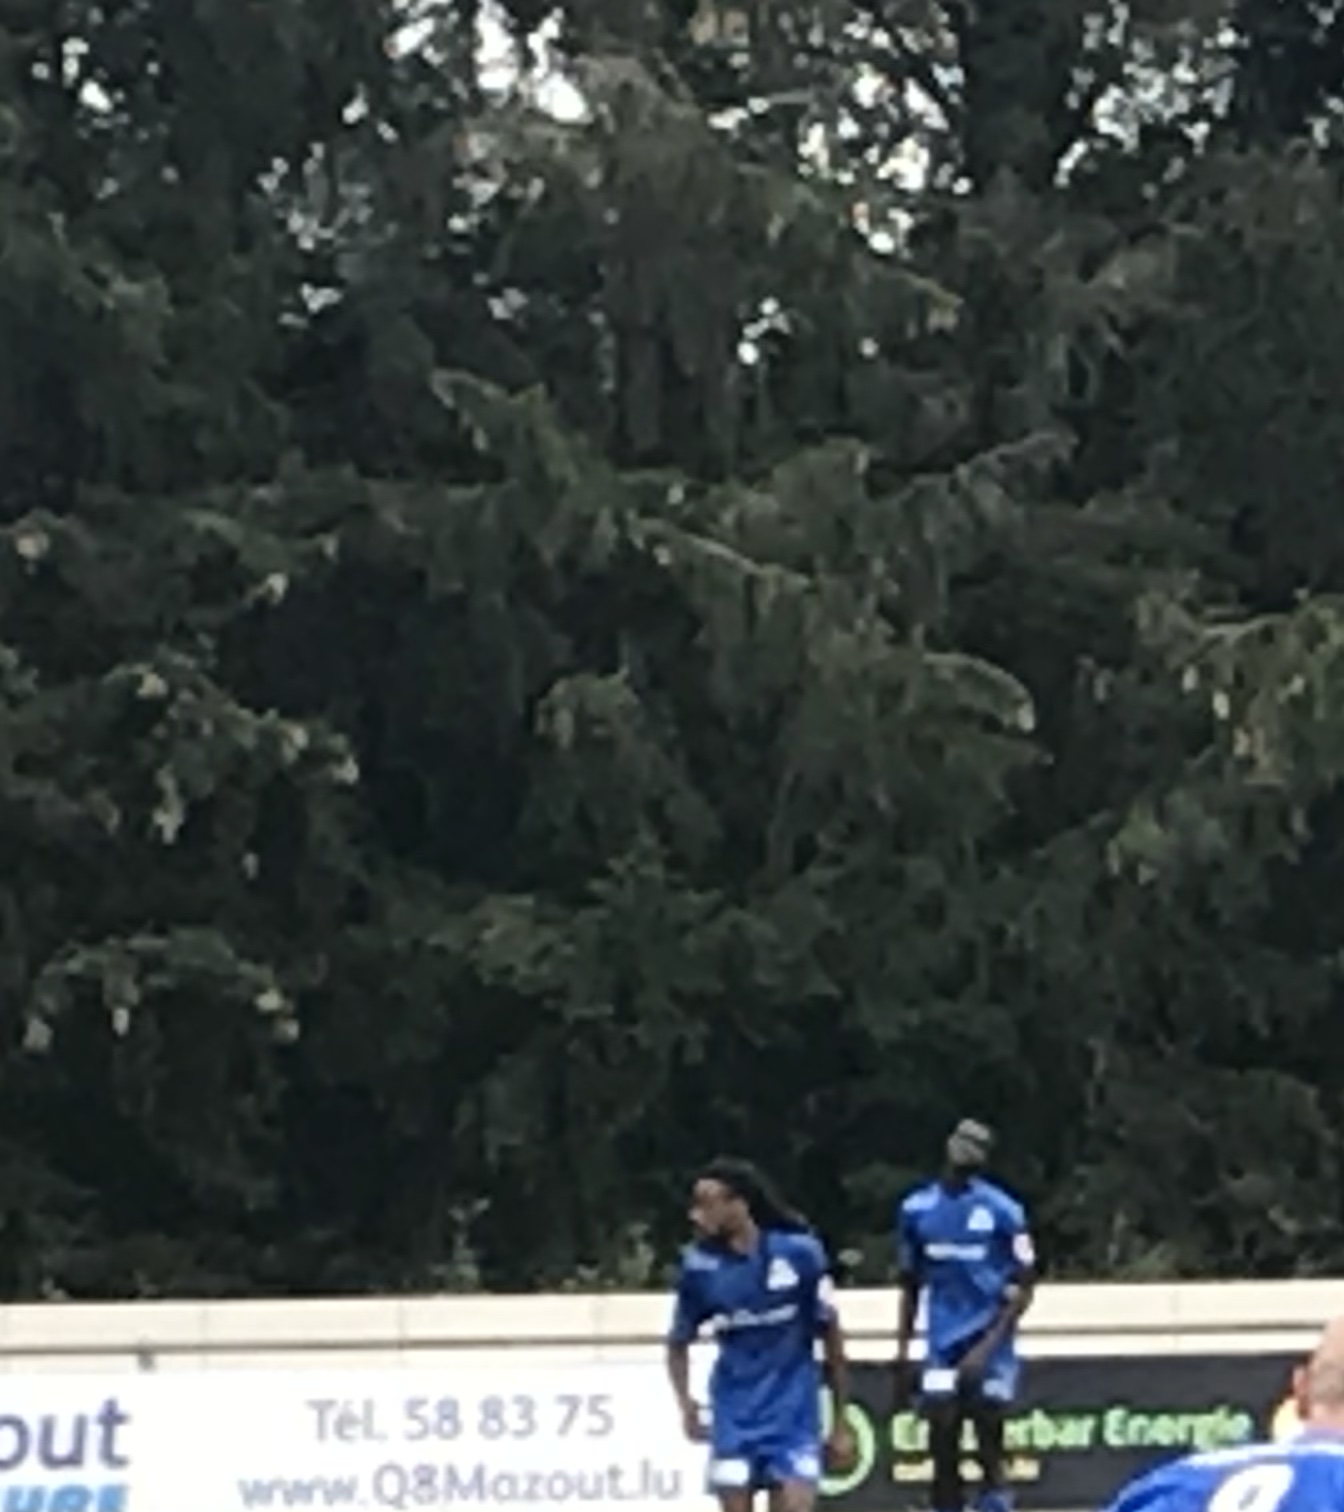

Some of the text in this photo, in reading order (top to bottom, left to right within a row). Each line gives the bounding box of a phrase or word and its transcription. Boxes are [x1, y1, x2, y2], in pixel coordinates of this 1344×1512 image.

[404, 1397, 463, 1441] 58
[478, 1395, 538, 1440] 83
[555, 1393, 614, 1438] 75
[237, 1459, 683, 1509] www.Q8Mazout.lu
